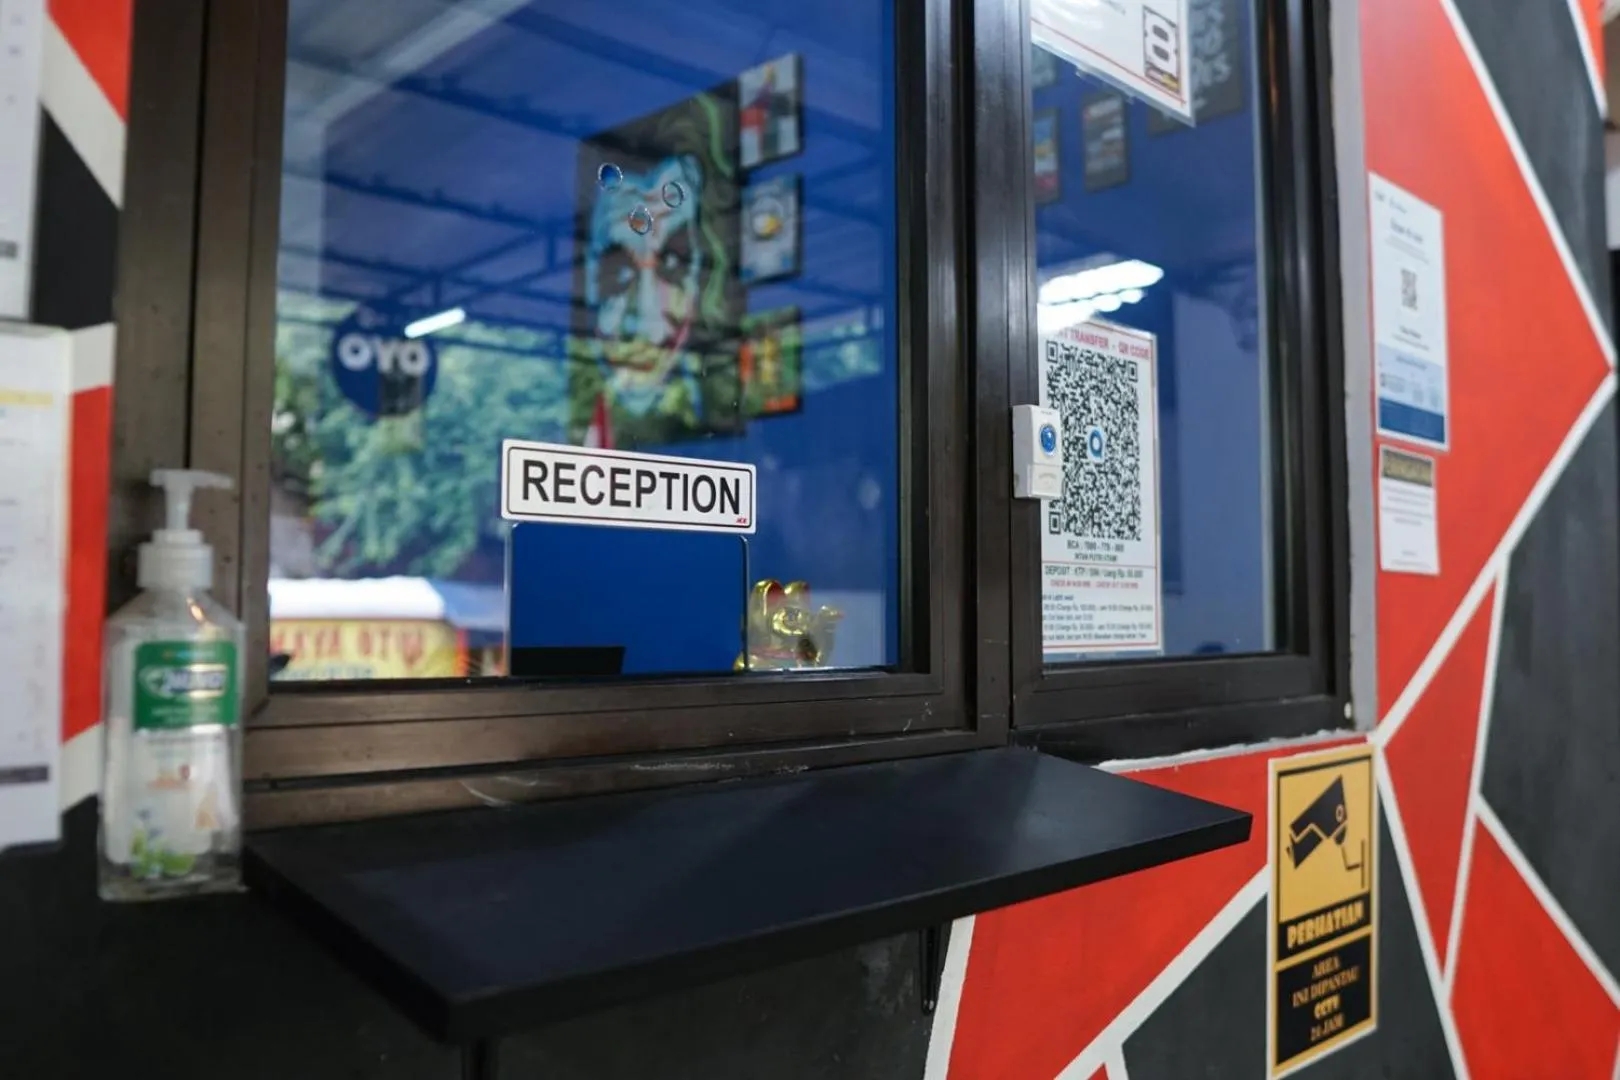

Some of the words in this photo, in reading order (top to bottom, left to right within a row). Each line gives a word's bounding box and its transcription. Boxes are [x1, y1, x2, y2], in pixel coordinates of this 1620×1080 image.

[337, 333, 431, 375] OYO
[1070, 328, 1109, 349] TRANSFER
[522, 459, 740, 515] RECEPTION
[1286, 900, 1364, 949] PERHATIAN
[1292, 987, 1309, 1007] INI
[1311, 965, 1360, 999] DIPANTAU
[1312, 956, 1340, 978] AREA
[1314, 995, 1340, 1018] CCTV
